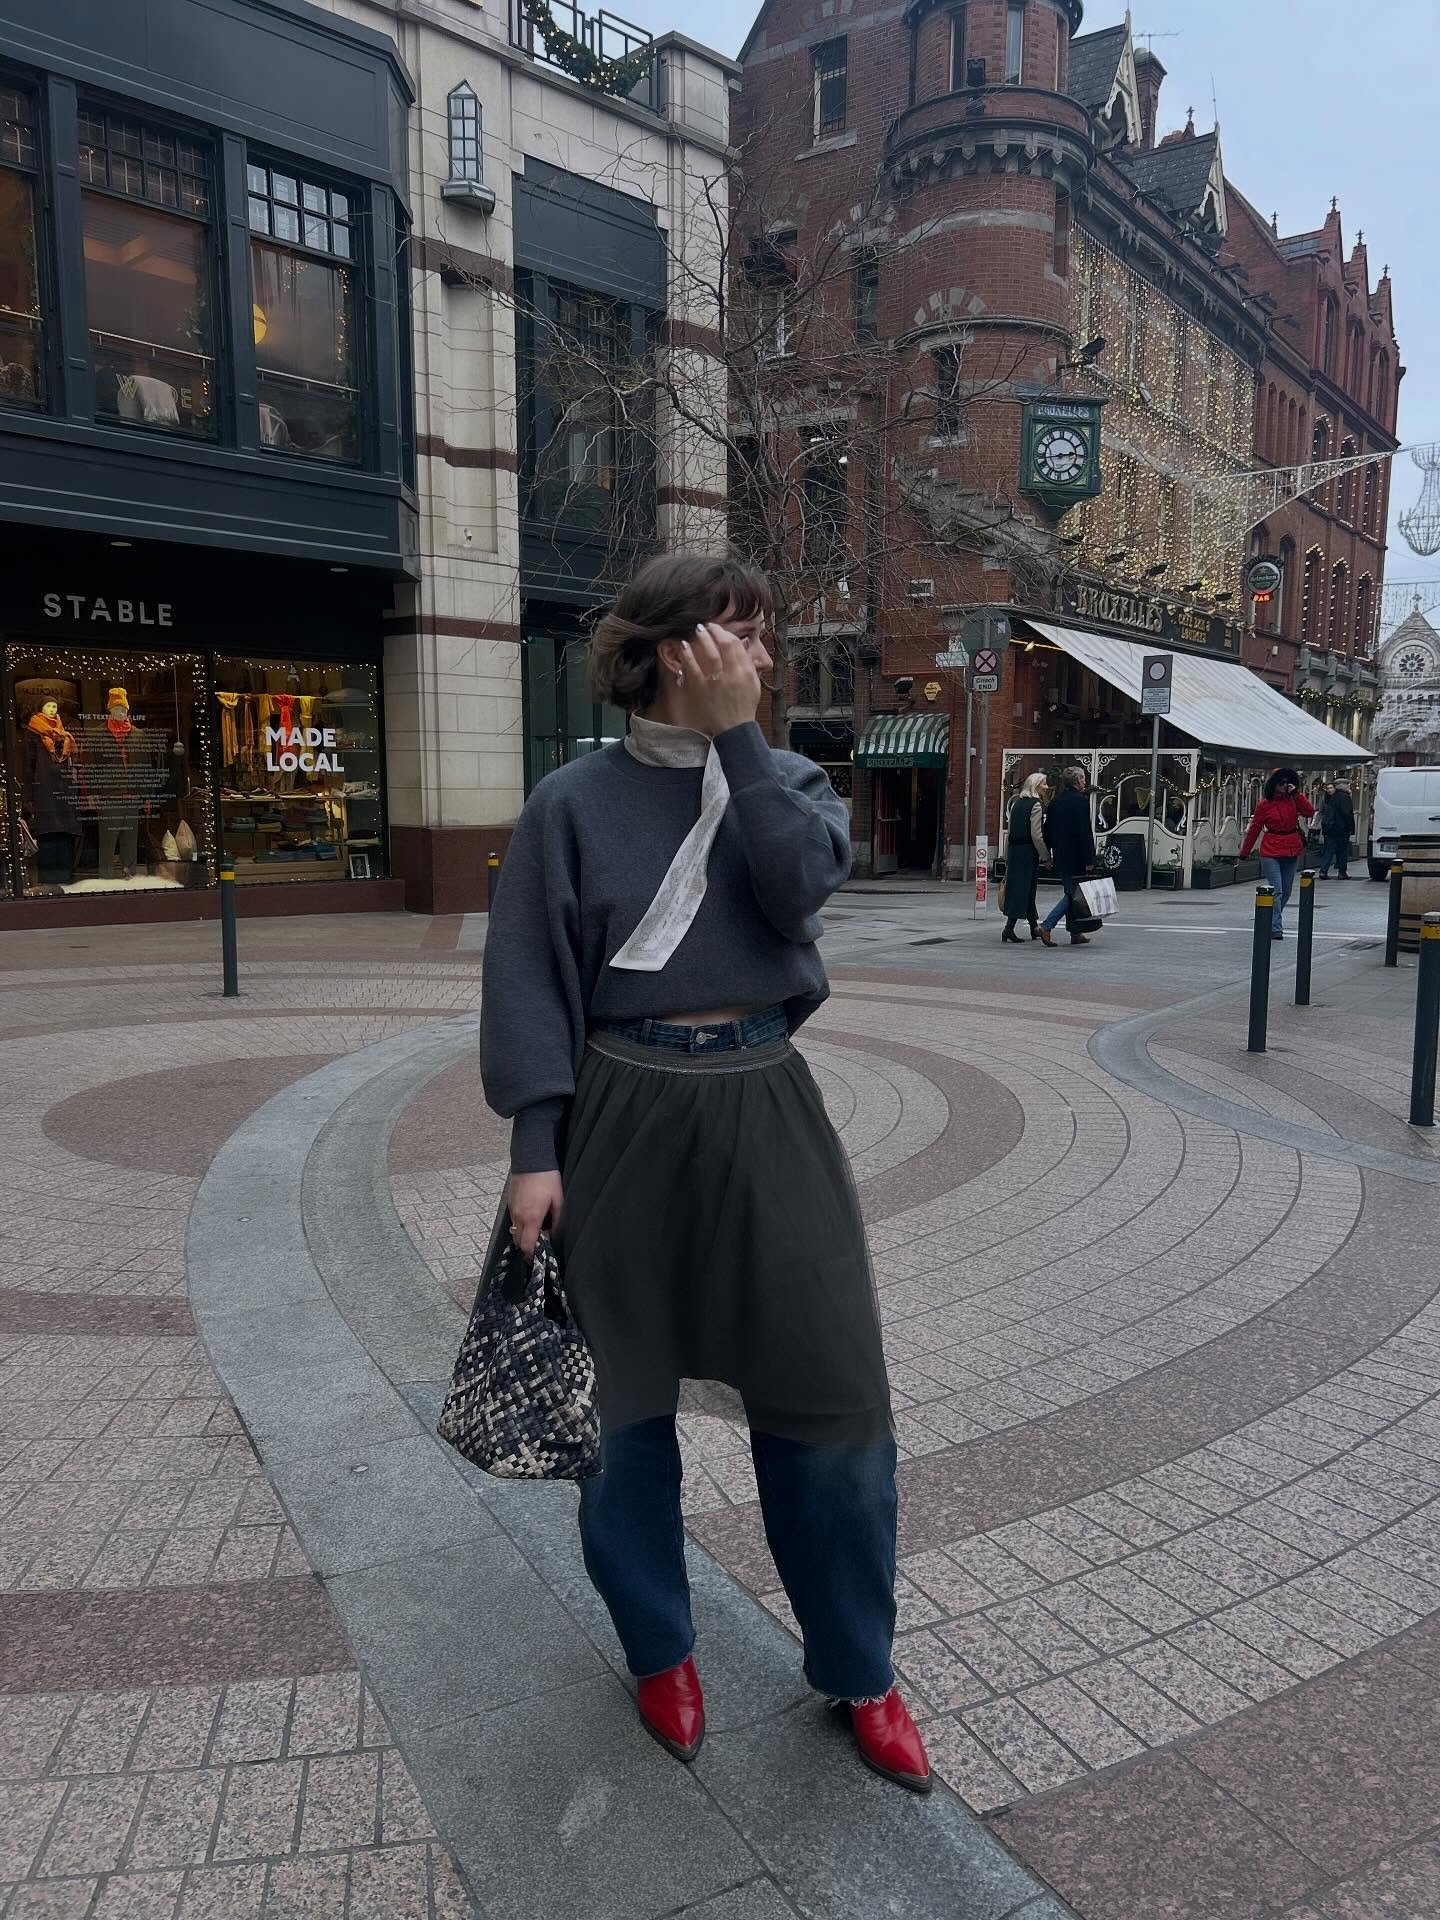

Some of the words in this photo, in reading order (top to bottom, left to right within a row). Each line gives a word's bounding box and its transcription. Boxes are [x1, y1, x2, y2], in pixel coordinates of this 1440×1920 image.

[1037, 405, 1090, 417] BRUXELLES
[43, 593, 173, 626] STABLE
[1076, 584, 1164, 633] BRUXELLES
[265, 726, 337, 747] MADE
[265, 752, 345, 772] LOCAL
